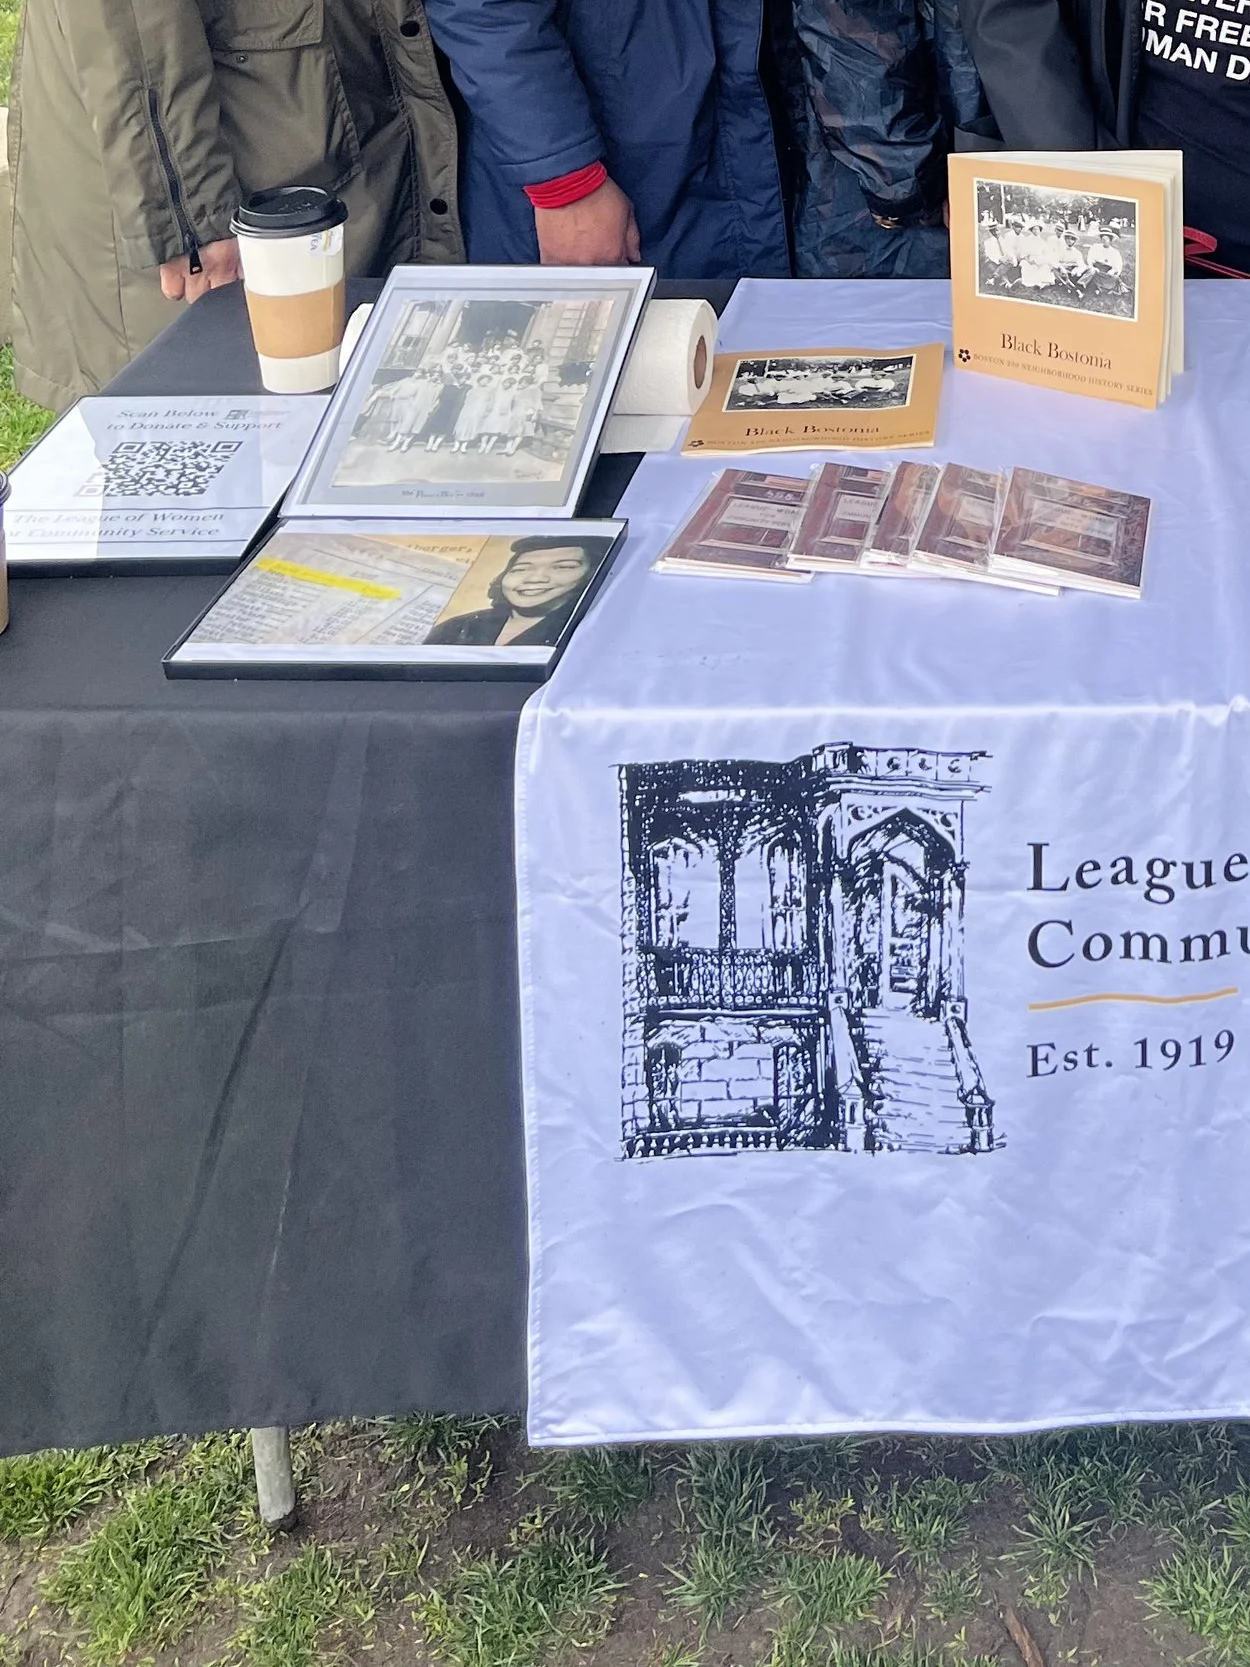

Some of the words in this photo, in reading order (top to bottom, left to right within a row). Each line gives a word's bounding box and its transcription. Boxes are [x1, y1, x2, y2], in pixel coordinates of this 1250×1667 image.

[1142, 26, 1218, 73] MAN
[1001, 333, 1042, 357] Black
[1048, 342, 1112, 370] Bostonia
[117, 409, 159, 418] Scan
[164, 409, 218, 418] Below
[107, 421, 121, 430] to
[123, 421, 192, 430] Donate
[214, 420, 283, 431] Support
[745, 425, 795, 436] Black
[803, 424, 879, 434] Bostonia
[125, 513, 146, 522] of
[153, 513, 223, 522] Women
[150, 526, 219, 536] Service
[1026, 842, 1249, 904] League
[1026, 1041, 1113, 1078] Est.
[1134, 1030, 1234, 1071] 1919
